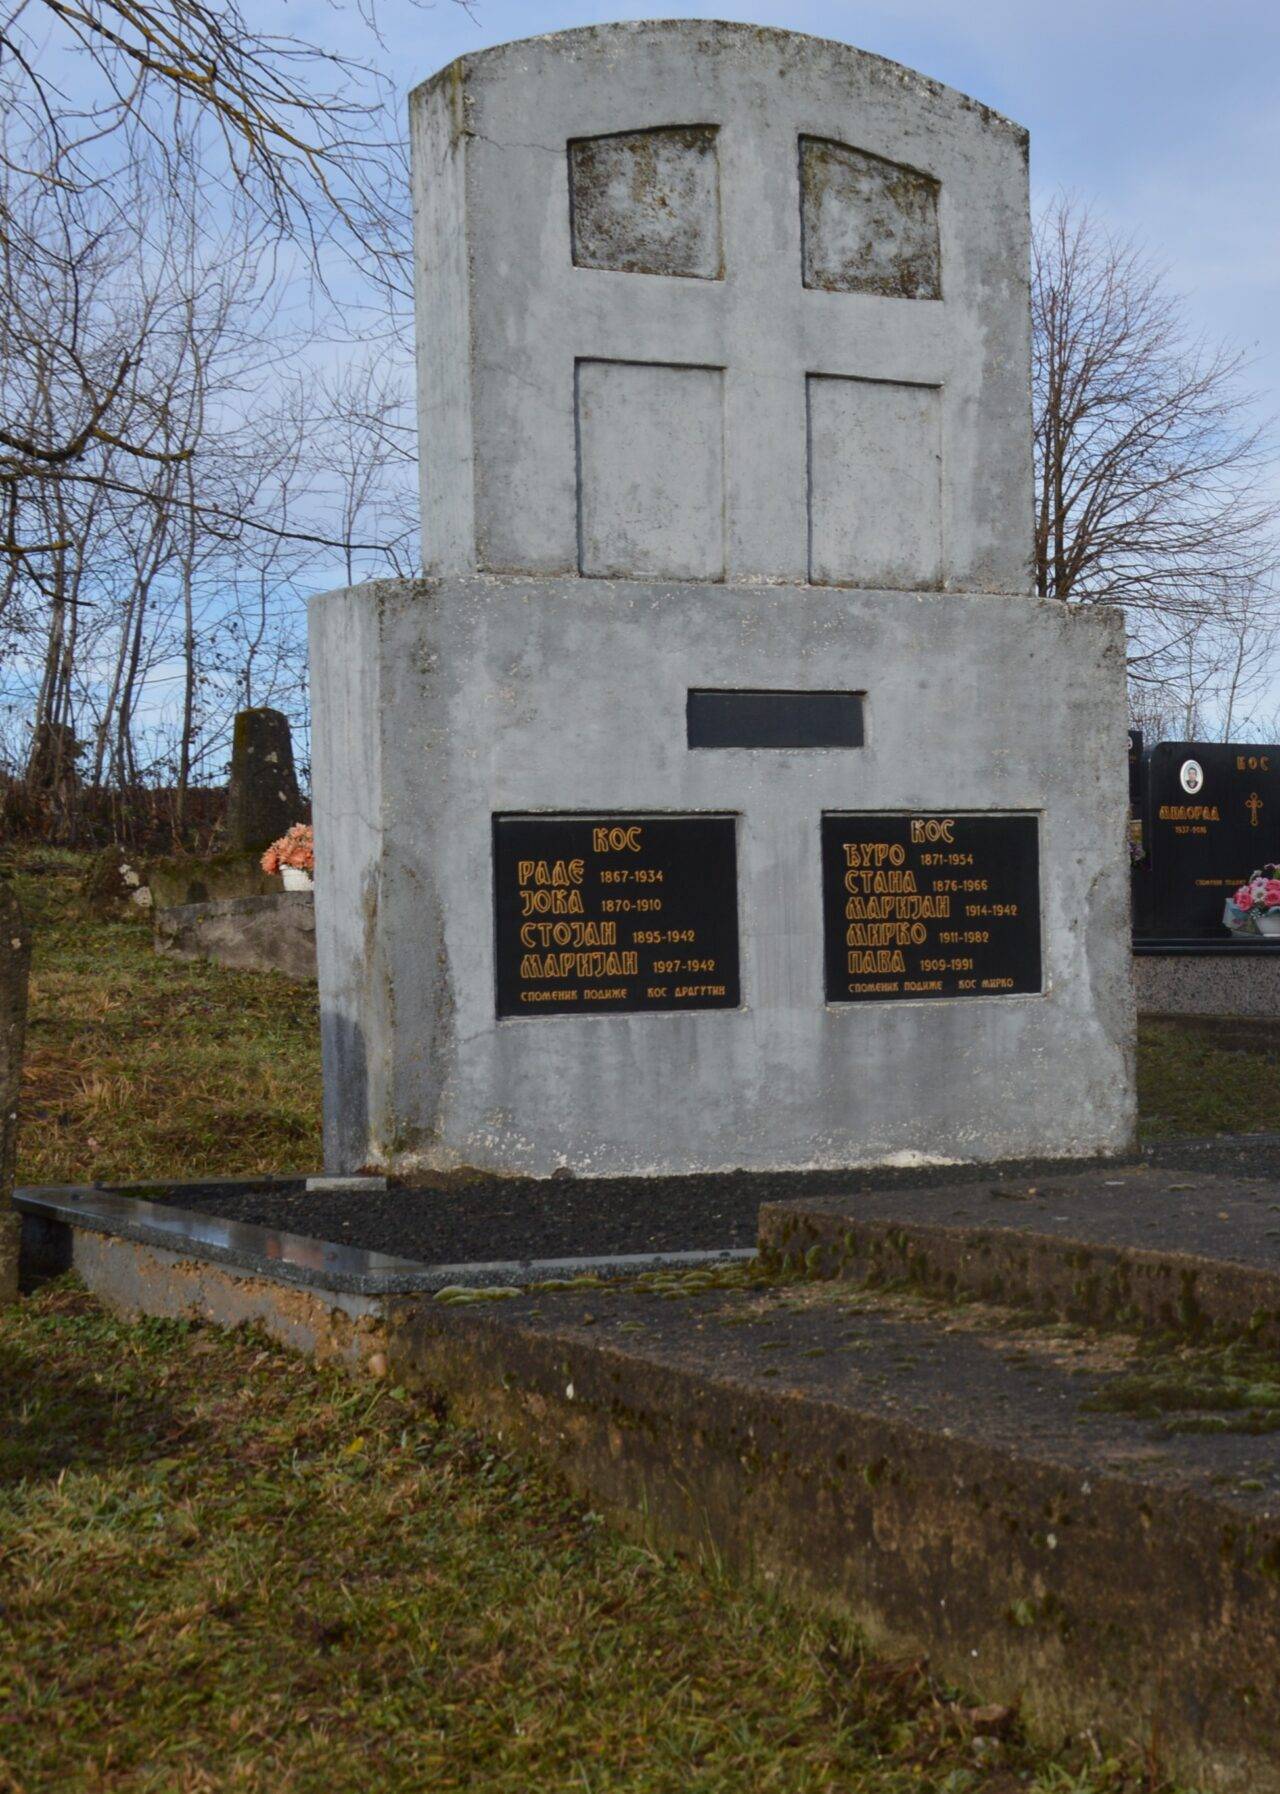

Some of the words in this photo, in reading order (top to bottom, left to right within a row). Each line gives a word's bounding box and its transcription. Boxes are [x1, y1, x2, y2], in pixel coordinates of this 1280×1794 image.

[592, 826, 642, 852] КОС
[910, 819, 955, 843] КОС
[843, 843, 906, 867] ЂУРО
[921, 853, 974, 866] 1871-1954
[518, 858, 585, 886] РАДЕ
[600, 870, 664, 884] 1867-1934
[844, 870, 918, 894] СТАНА
[933, 879, 988, 892] 1876-1966
[519, 889, 584, 916] ЈОКА
[601, 899, 662, 913] 1870-1910
[845, 896, 951, 920] МАРИЈАН
[965, 904, 1018, 917] 1914-1942
[520, 921, 617, 948] СТОЈАН
[633, 930, 696, 944] 1895-1942
[846, 922, 927, 946] МИРКО
[939, 931, 989, 943] 1911-1982
[520, 951, 638, 978] МАРИЈАН
[653, 960, 716, 973] 1927-1942
[848, 950, 906, 974] ПАВА
[920, 959, 973, 971] 1909-1991
[521, 989, 577, 1002] СПОМЕНИК
[584, 988, 628, 1000] ПОДИЖЕ
[647, 987, 667, 998] КОС
[674, 985, 726, 997] ДРАГУТИН
[848, 981, 899, 993] СПОМЕНИК
[904, 980, 943, 991] ПОДИЖЕ
[958, 979, 977, 989] КОС
[981, 977, 1014, 988] МИРКО
